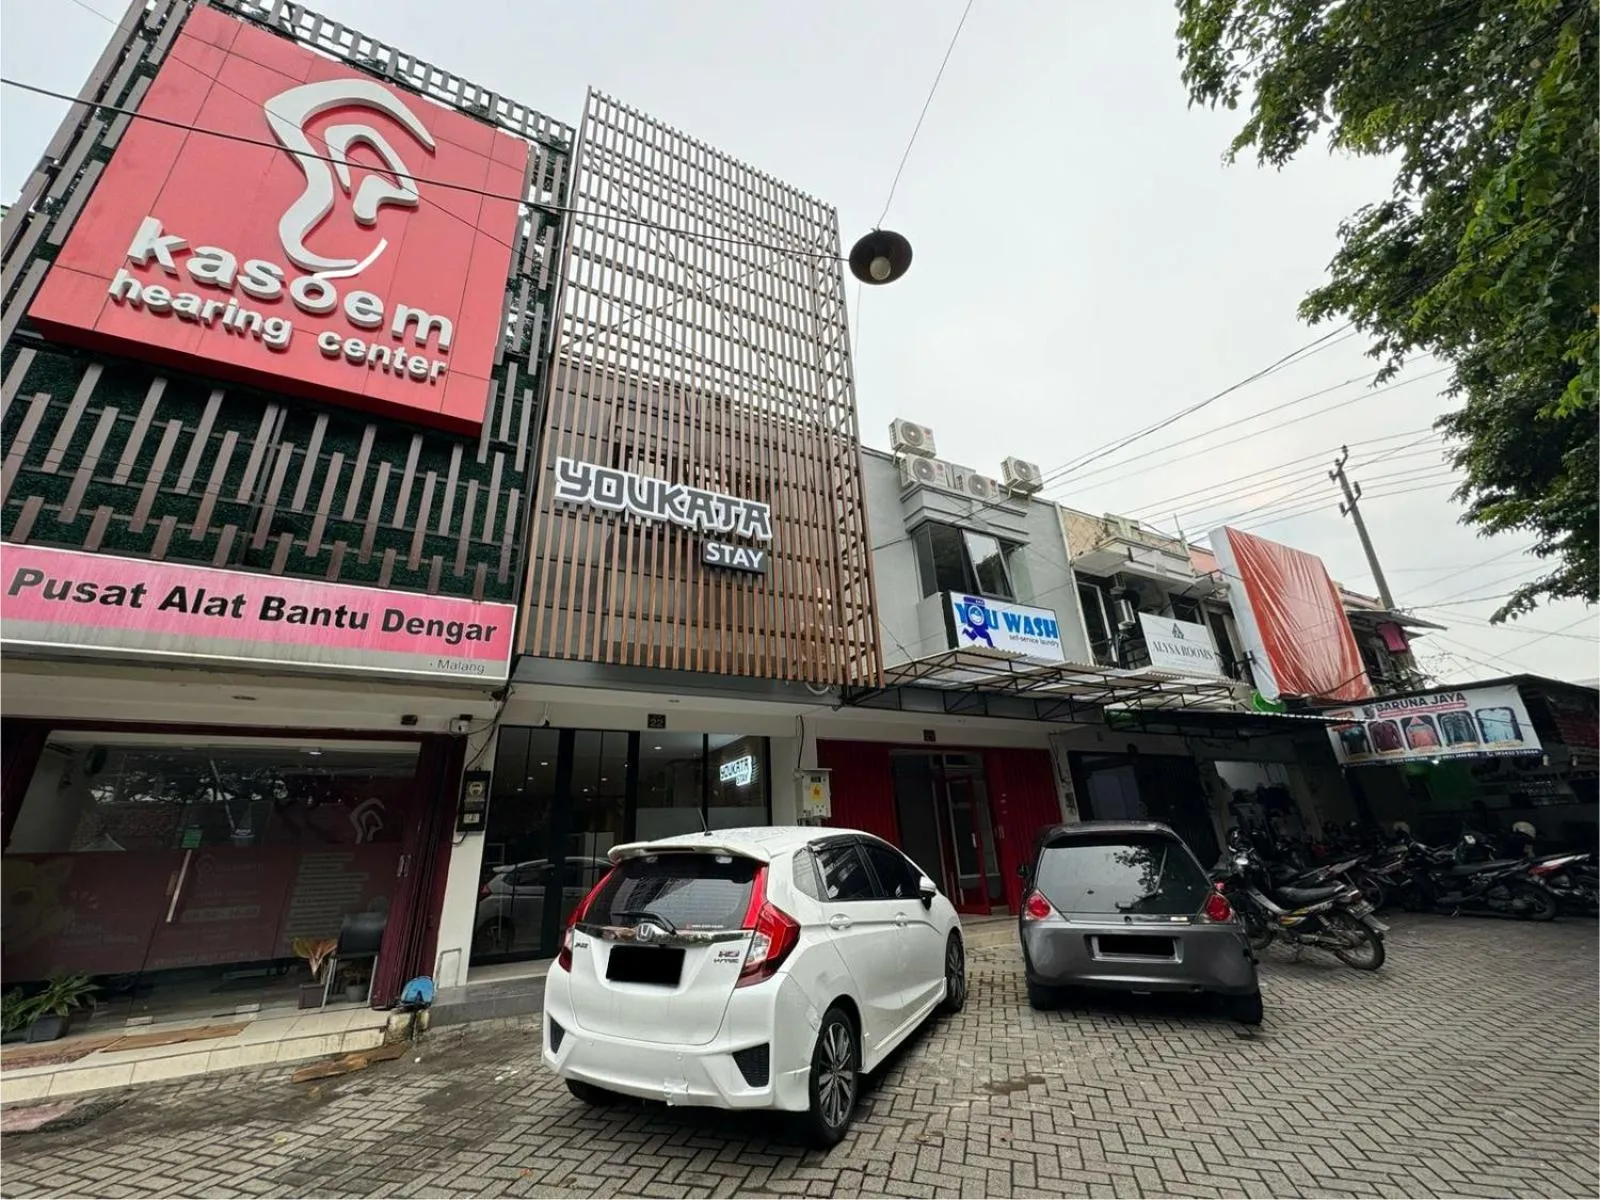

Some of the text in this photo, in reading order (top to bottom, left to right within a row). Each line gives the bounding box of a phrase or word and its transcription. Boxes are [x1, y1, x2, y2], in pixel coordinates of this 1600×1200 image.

[126, 216, 453, 352] kasoem
[107, 269, 447, 382] hearing center
[706, 542, 763, 568] STAY
[7, 566, 498, 645] Pusat Alat Bantu Dengar
[1002, 612, 1058, 639] WASH
[437, 658, 485, 676] Malang
[1430, 691, 1467, 705] JAYA
